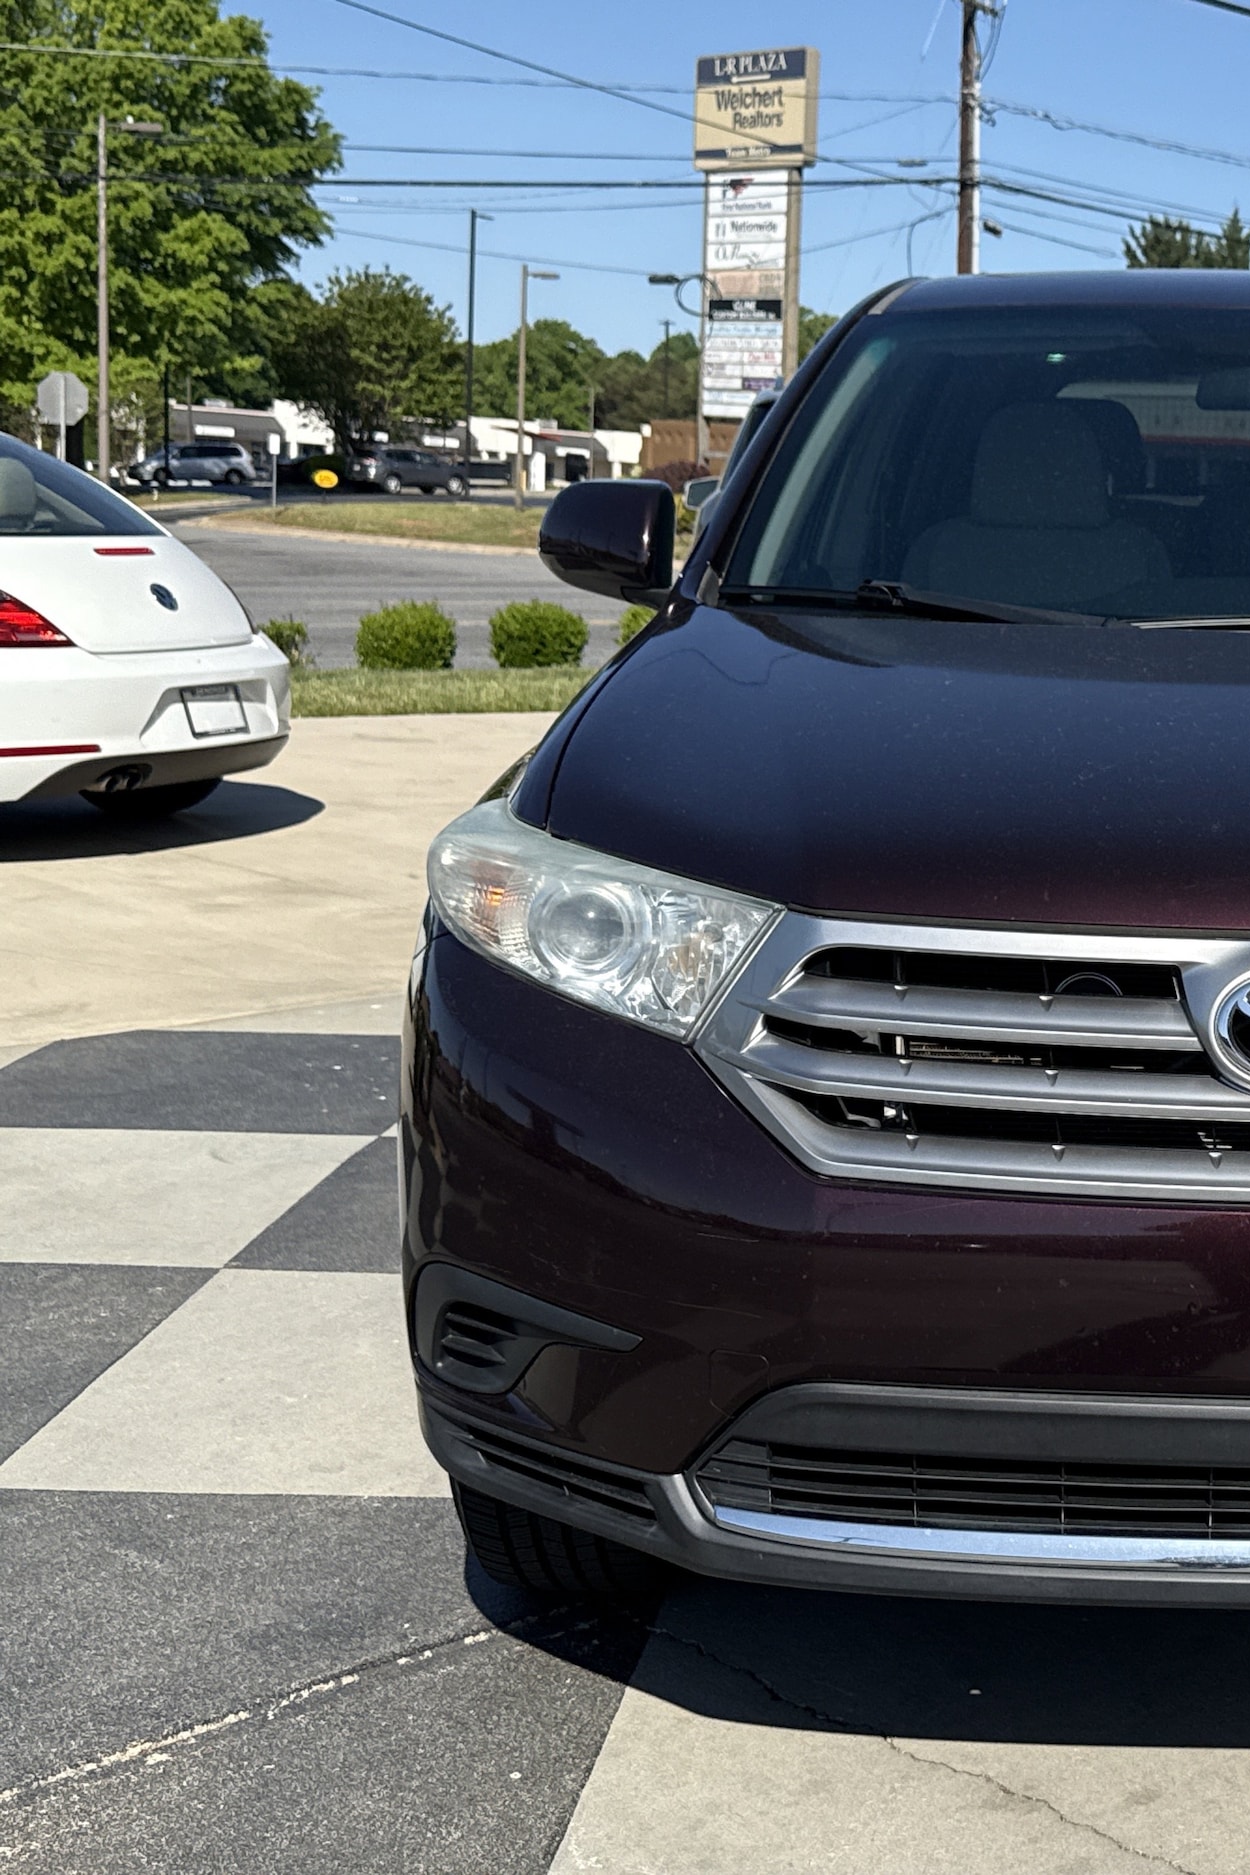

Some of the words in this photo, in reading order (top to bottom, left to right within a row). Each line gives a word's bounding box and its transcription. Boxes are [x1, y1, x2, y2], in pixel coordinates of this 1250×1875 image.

[739, 52, 787, 74] PLAZA
[715, 86, 784, 111] Weichert
[733, 111, 784, 130] Realtors
[730, 221, 777, 233] Nationwide
